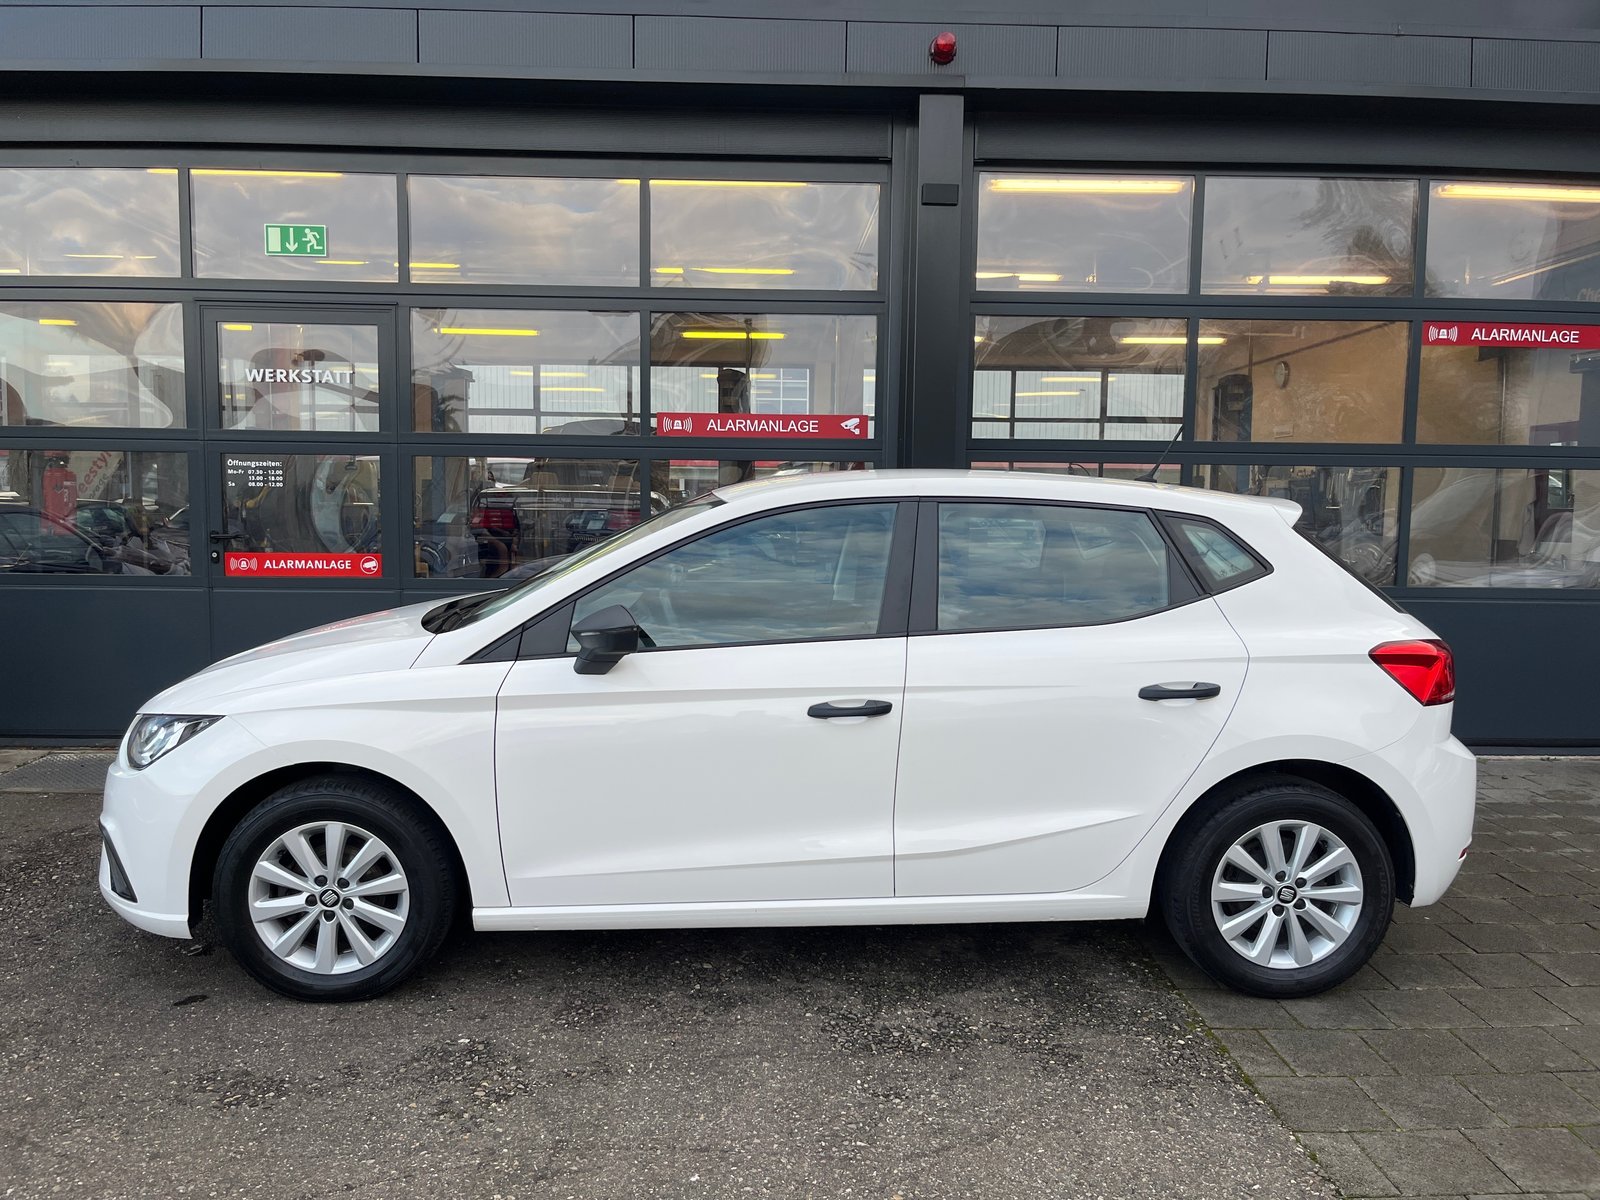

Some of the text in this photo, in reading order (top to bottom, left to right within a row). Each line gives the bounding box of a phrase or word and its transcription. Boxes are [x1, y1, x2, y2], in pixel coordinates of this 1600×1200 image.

[1471, 328, 1580, 343] ALARMANLAGE
[245, 368, 353, 384] WERKSTATT
[706, 419, 819, 433] ALARMANLAGE
[227, 459, 282, 468] Öffnungszeiten:
[264, 559, 352, 570] ALARMANLAGE
